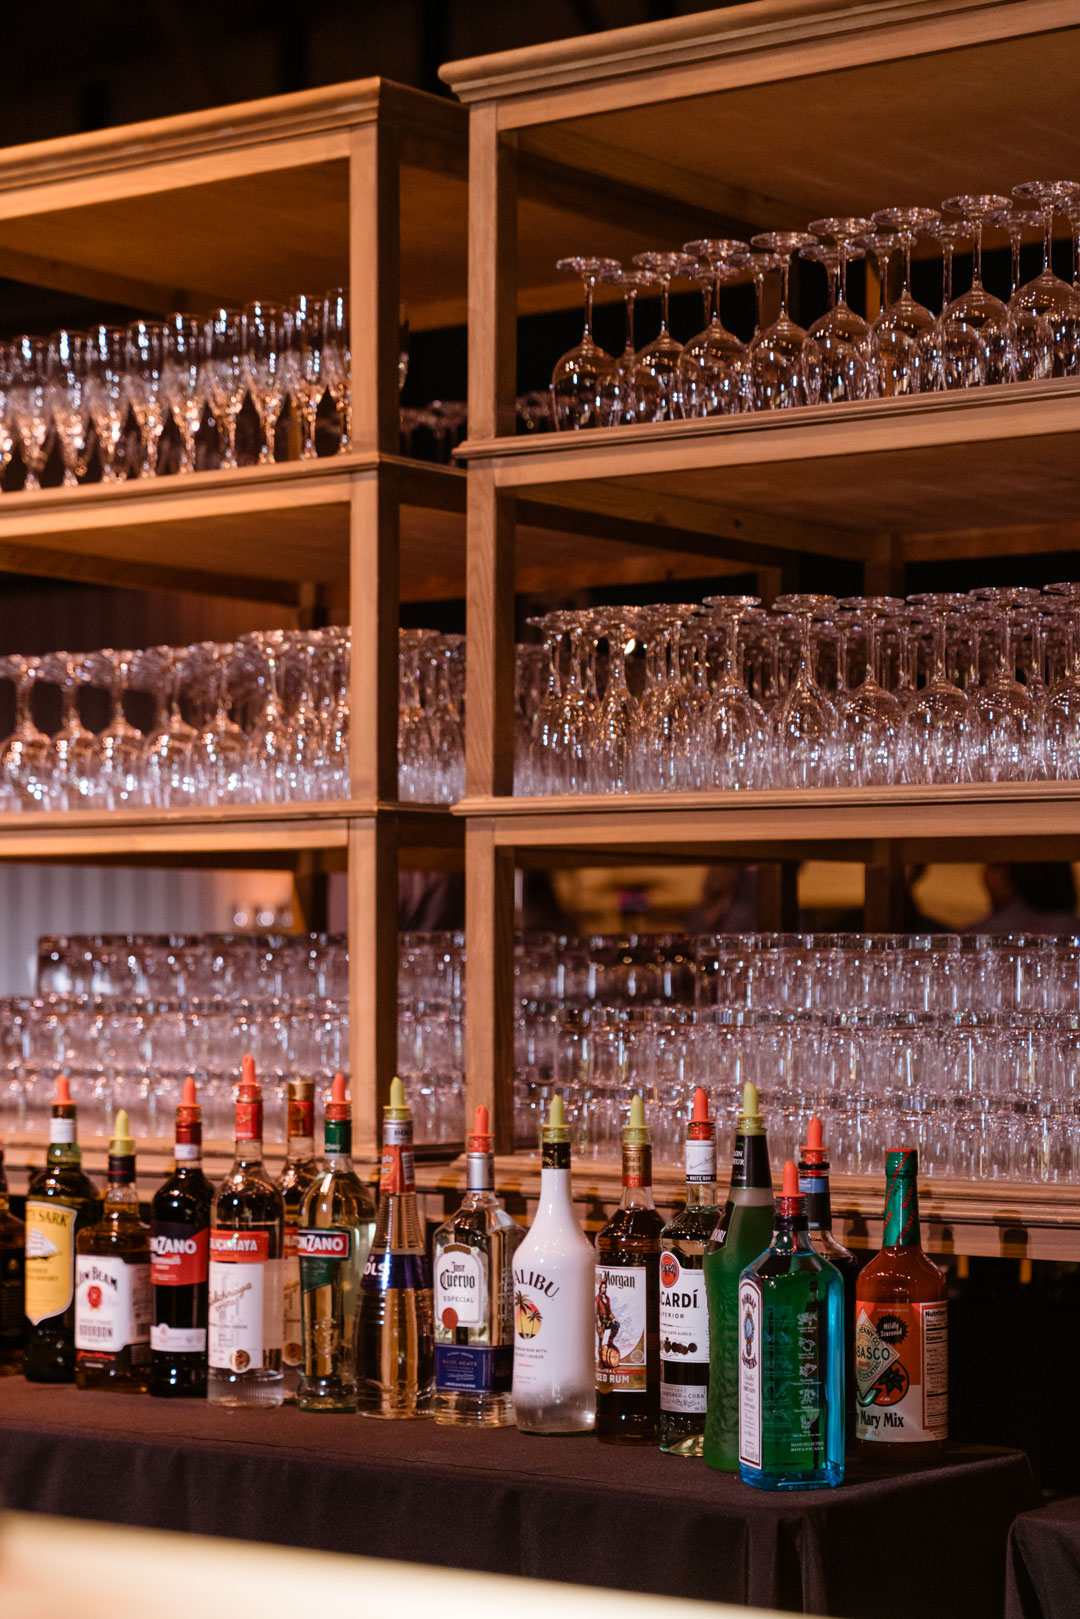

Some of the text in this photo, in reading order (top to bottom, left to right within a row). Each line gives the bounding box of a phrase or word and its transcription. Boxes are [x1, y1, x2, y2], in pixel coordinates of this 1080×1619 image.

[37, 1210, 70, 1228] SARK
[440, 1269, 476, 1291] Cuervo
[602, 1270, 636, 1290] Morgan
[443, 1295, 475, 1304] ESPECIAL
[883, 1321, 899, 1331] Mildly
[609, 1374, 630, 1384] RUM
[860, 1410, 881, 1430] Mary
[883, 1412, 905, 1428] Mix
